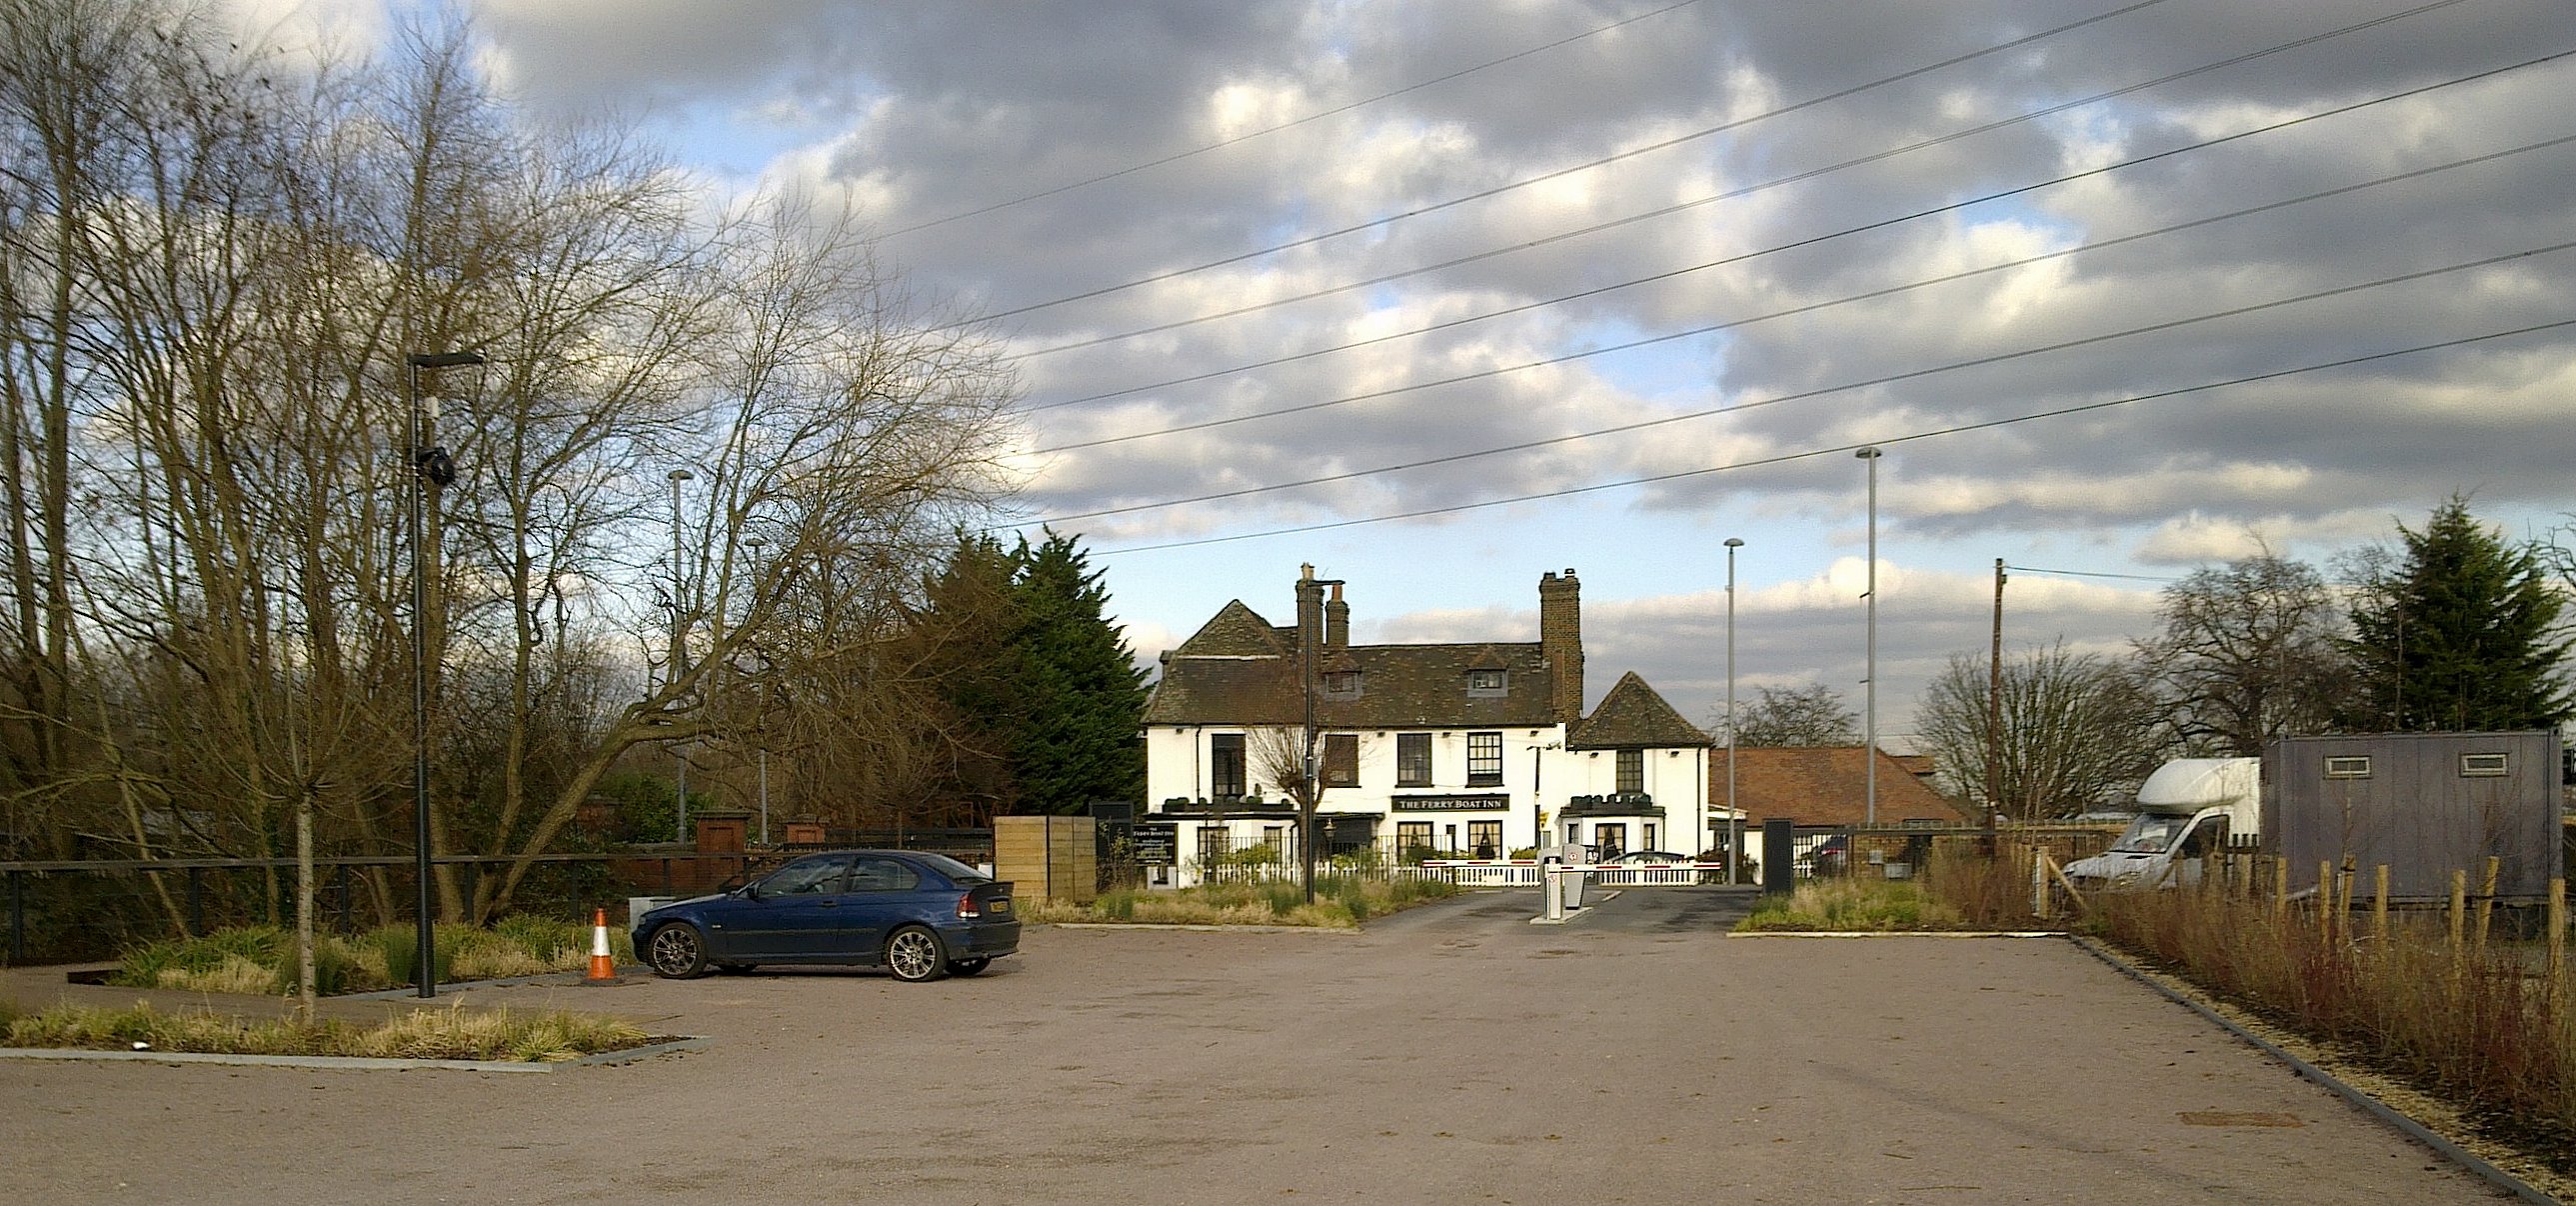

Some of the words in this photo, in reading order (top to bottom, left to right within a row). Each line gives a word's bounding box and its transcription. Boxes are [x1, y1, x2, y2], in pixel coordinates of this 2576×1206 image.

[1399, 800, 1419, 809] THE
[1421, 800, 1453, 809] FERRY
[1455, 800, 1480, 808] BOAT
[1482, 799, 1501, 808] INN
